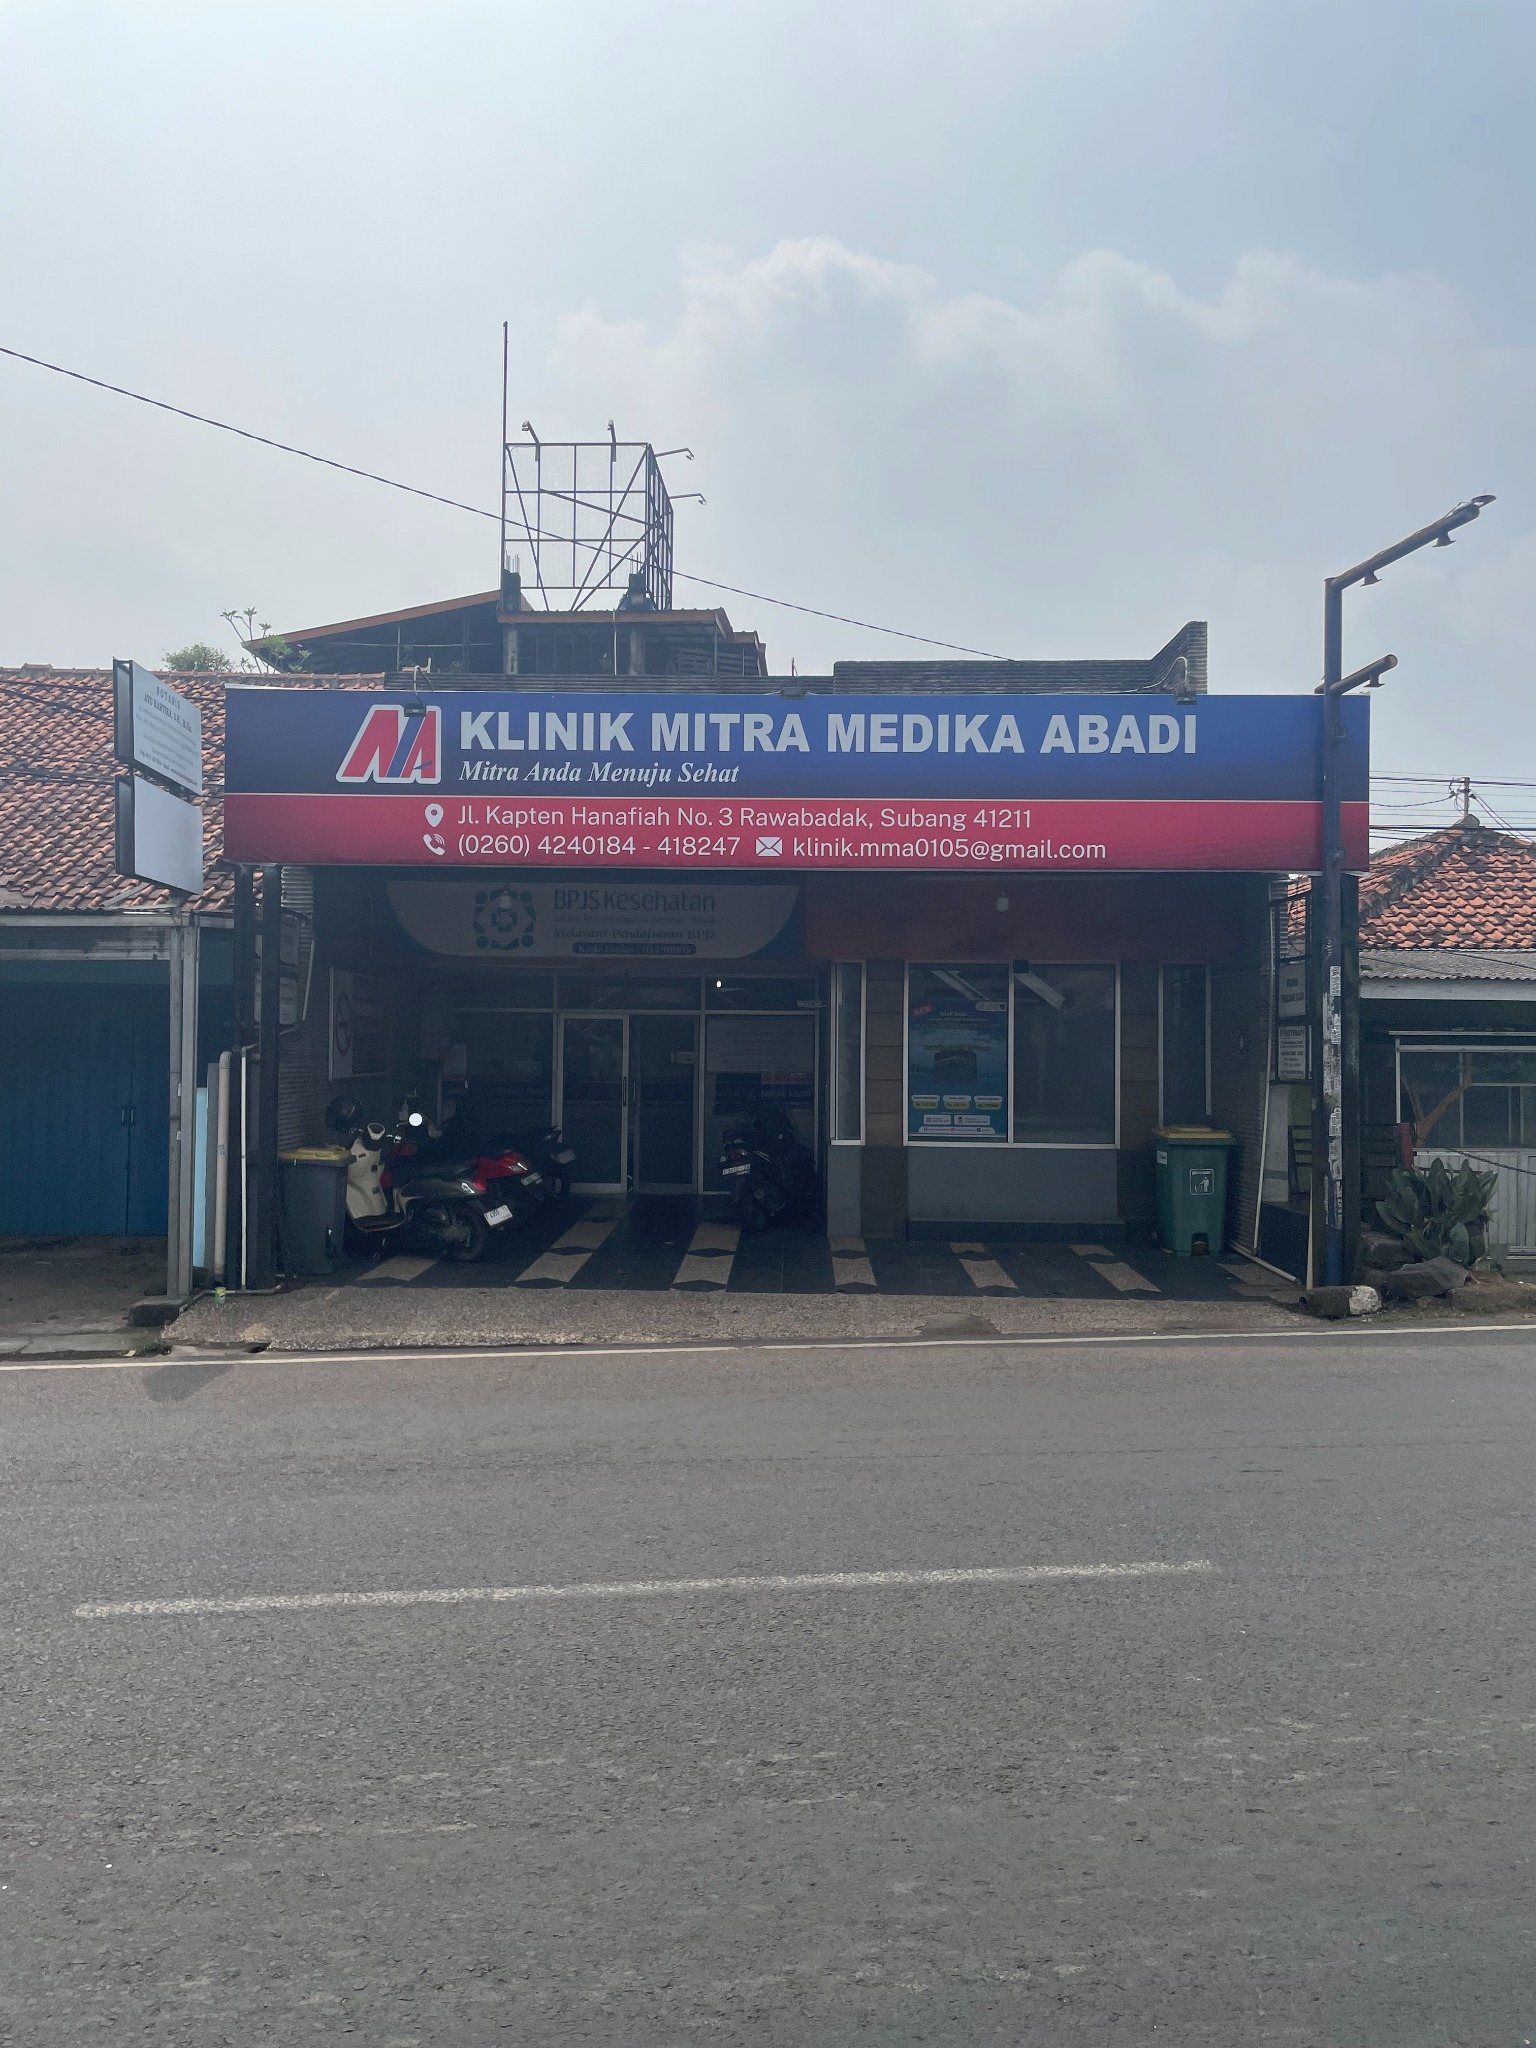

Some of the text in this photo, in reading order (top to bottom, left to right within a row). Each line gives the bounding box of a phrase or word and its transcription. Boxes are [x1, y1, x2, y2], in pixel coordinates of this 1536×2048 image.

[460, 712, 1197, 754] KLINIK MITRA MEDIKA ABADI
[459, 761, 740, 788] Mitra Anda Menuju Sehat
[458, 805, 1031, 832] Jl. Kapten Hanafiah No. 3 Rawabadak, Subang 41211
[458, 834, 530, 857] (0260)
[538, 836, 636, 855] 4240184
[657, 836, 741, 856] 418247
[793, 838, 1106, 862] klinik.mma0105@gmail.com
[554, 889, 716, 911] BPJS Kesehatan
